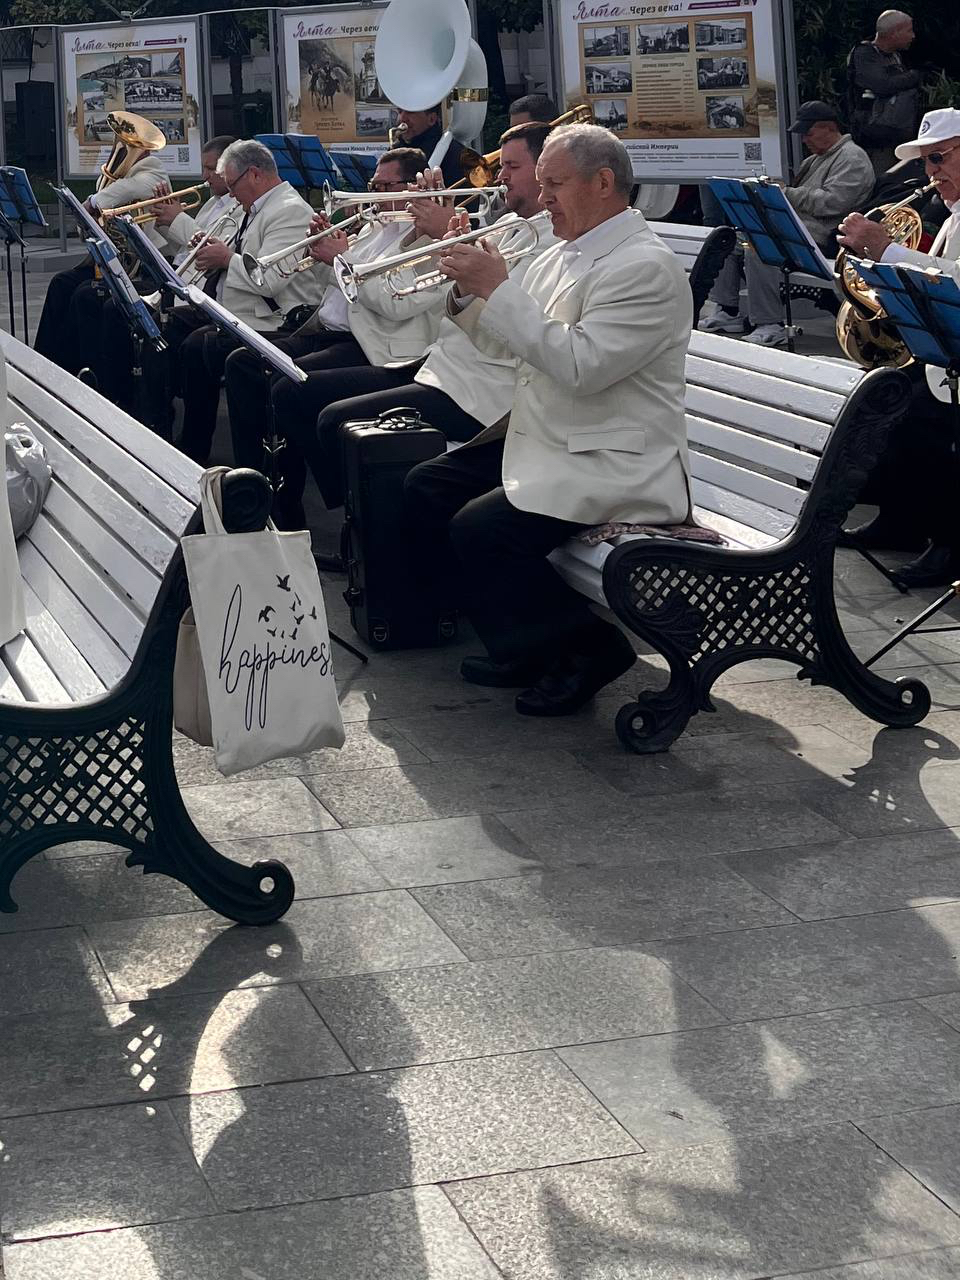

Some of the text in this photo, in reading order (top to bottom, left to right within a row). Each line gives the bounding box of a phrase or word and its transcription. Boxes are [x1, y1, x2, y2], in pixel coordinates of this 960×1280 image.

[573, 0, 623, 20] Ялта
[629, 5, 656, 16] Через
[658, 2, 683, 13] века!
[293, 20, 337, 38] Ялта
[340, 25, 363, 35] Через
[107, 41, 125, 50] Через
[219, 583, 335, 732] happines
